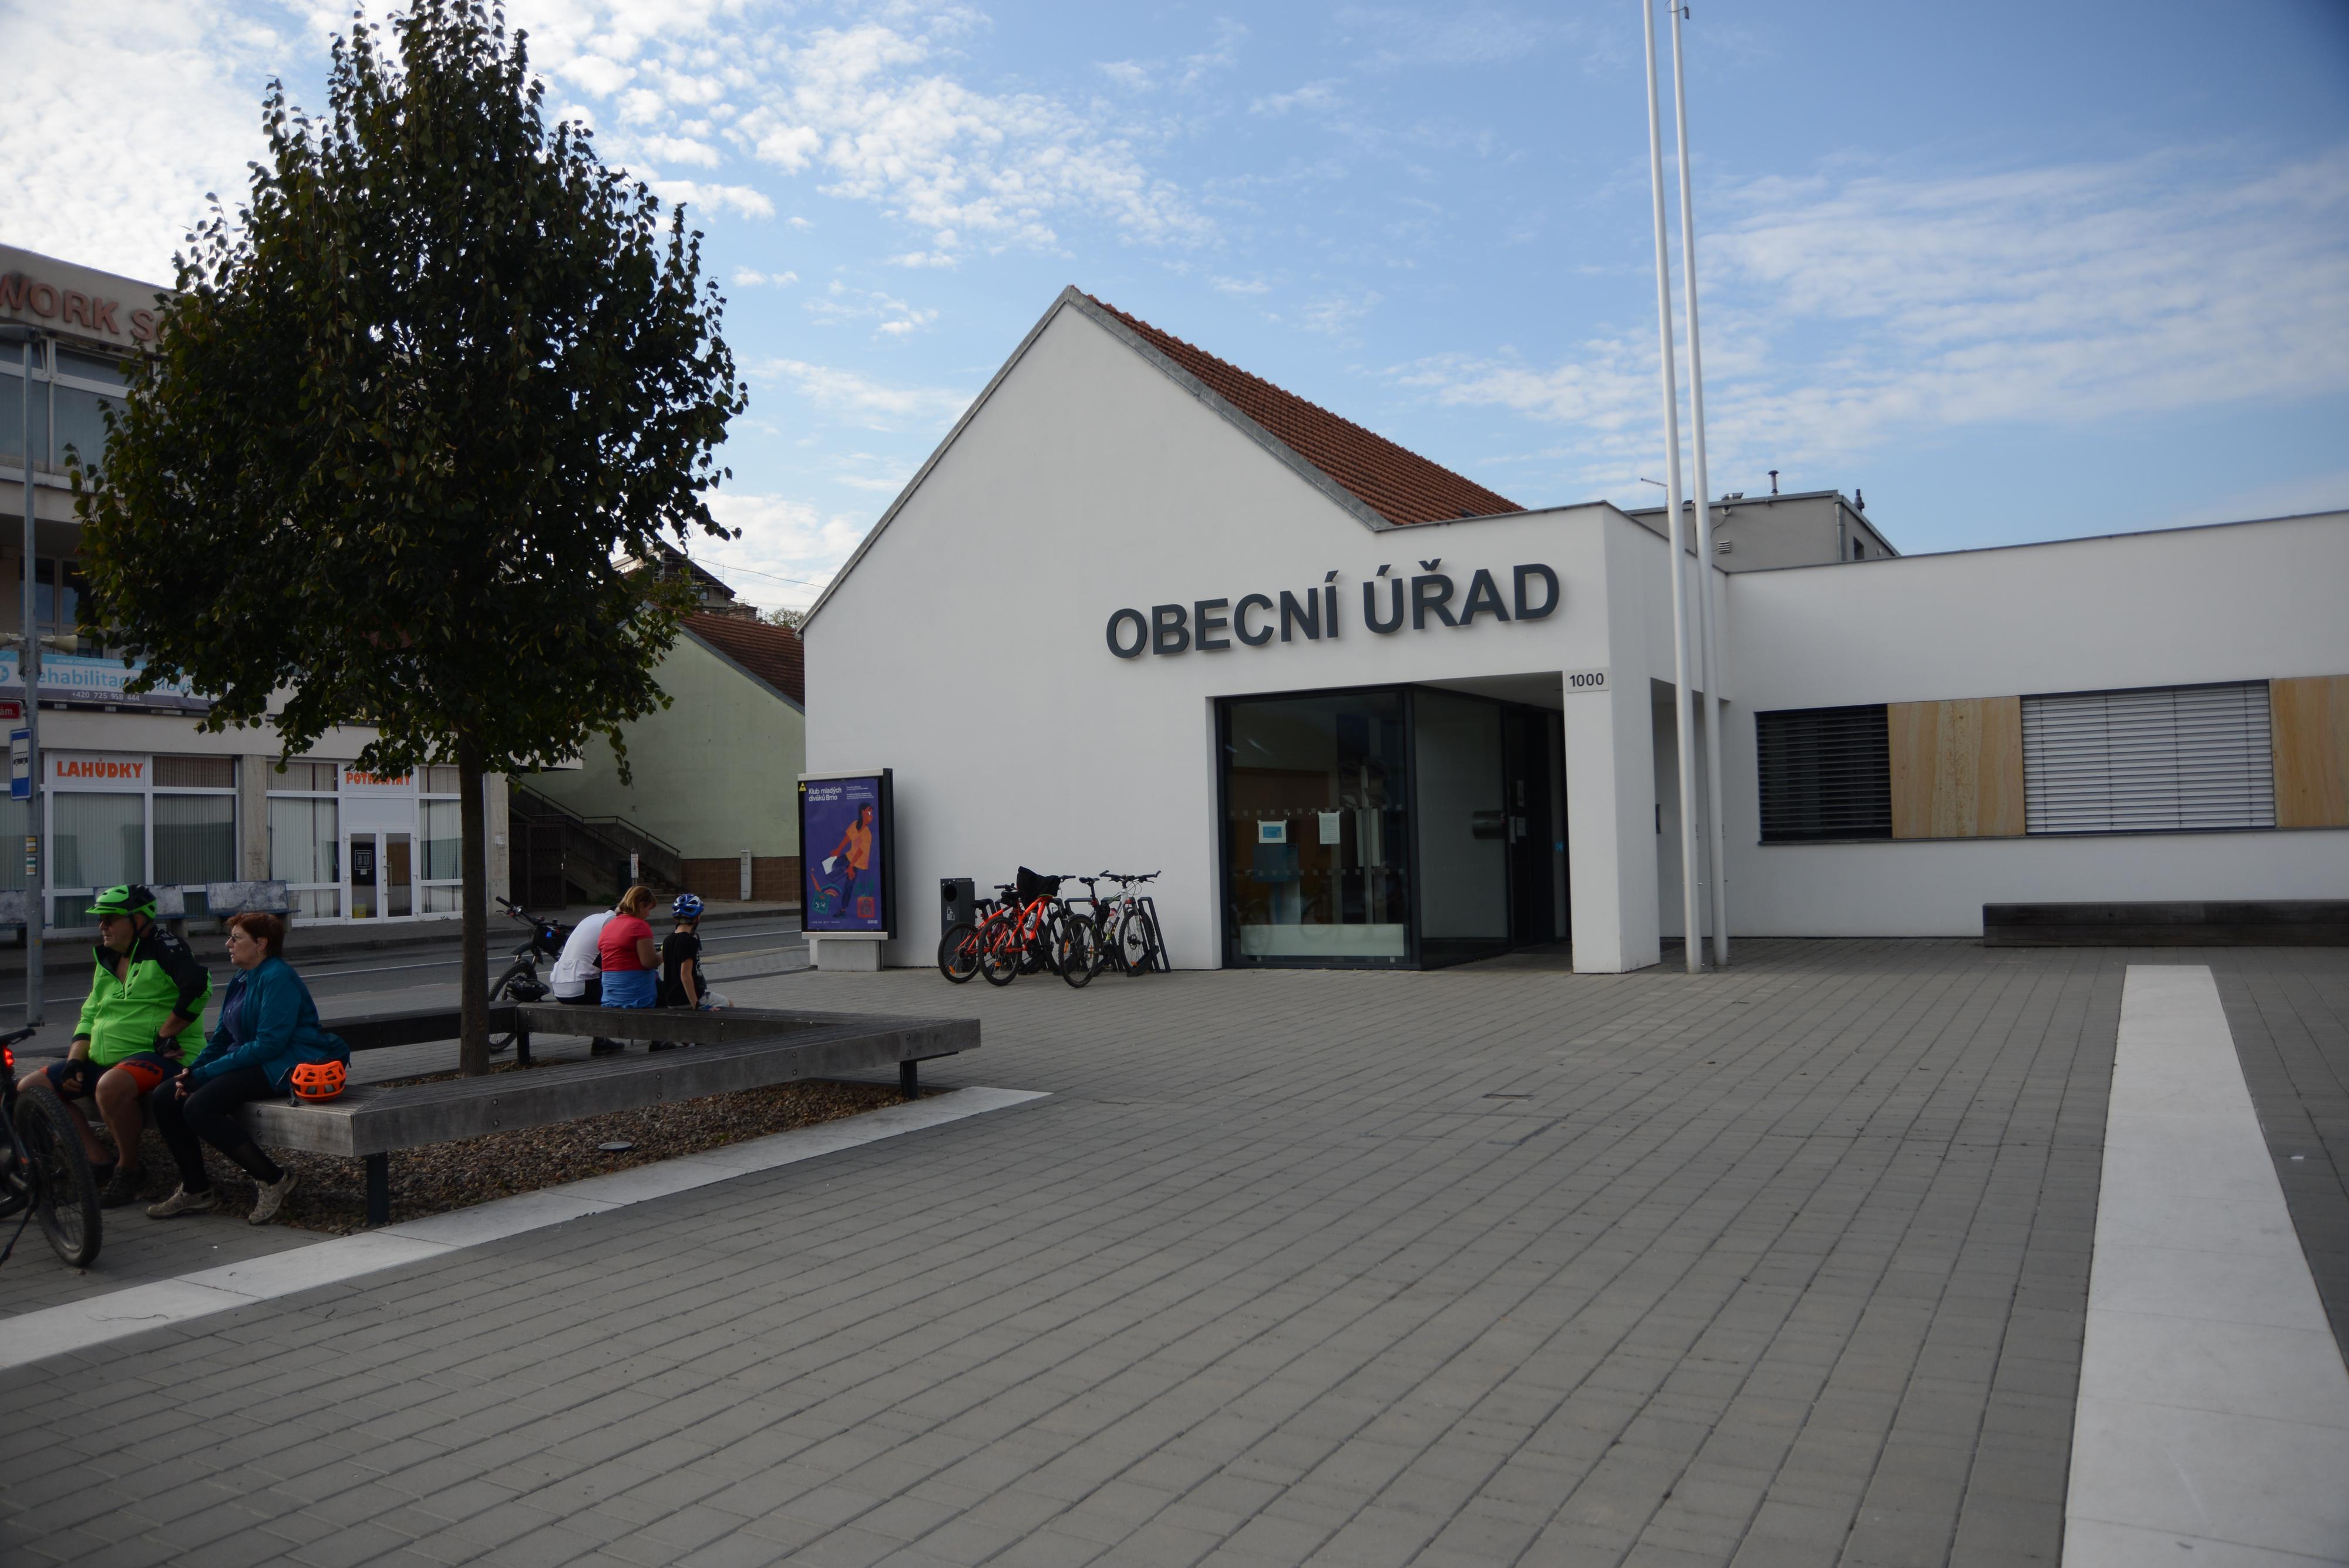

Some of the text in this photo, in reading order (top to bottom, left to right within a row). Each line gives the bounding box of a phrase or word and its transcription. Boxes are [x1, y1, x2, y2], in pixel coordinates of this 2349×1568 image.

[1106, 558, 1560, 659] OBECNÍ ÚŘAD
[38, 667, 137, 687] ehabilitac
[1569, 672, 1604, 687] 1000
[57, 757, 143, 778] LAHŮDKY
[820, 786, 842, 795] mladých
